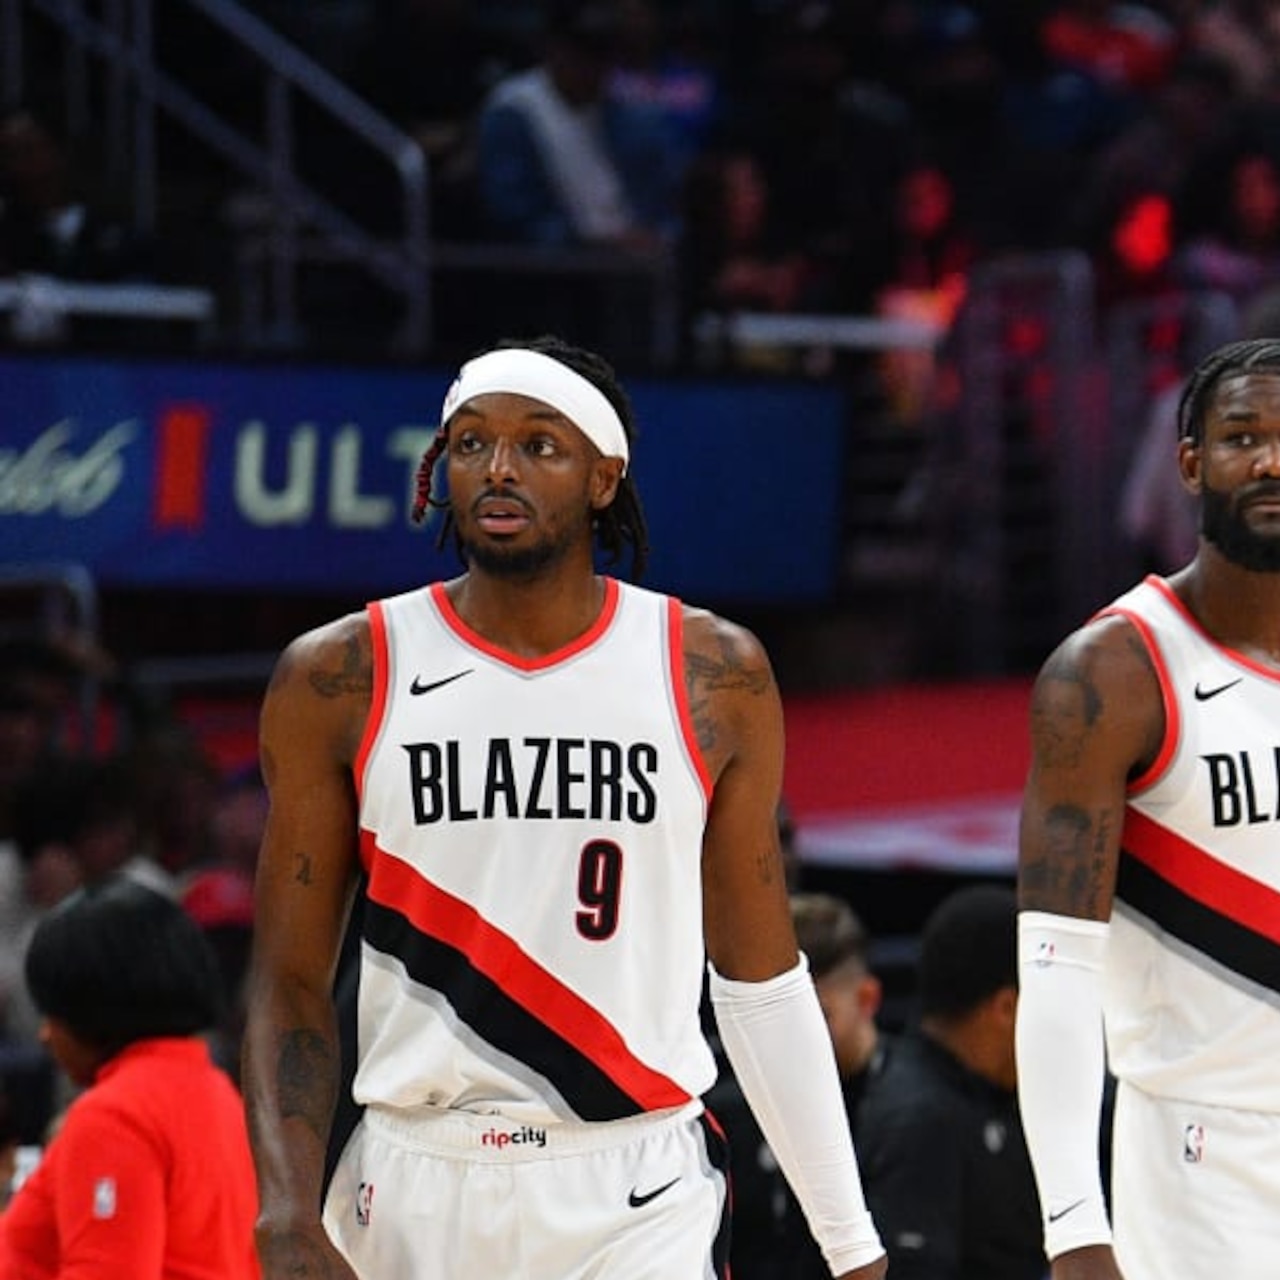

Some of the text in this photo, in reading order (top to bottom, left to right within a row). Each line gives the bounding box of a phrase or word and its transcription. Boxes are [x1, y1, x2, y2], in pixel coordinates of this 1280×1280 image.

[235, 421, 445, 528] ULT
[402, 737, 658, 825] BLAZERS
[575, 838, 623, 942] 9
[481, 1126, 547, 1150] ripcity
